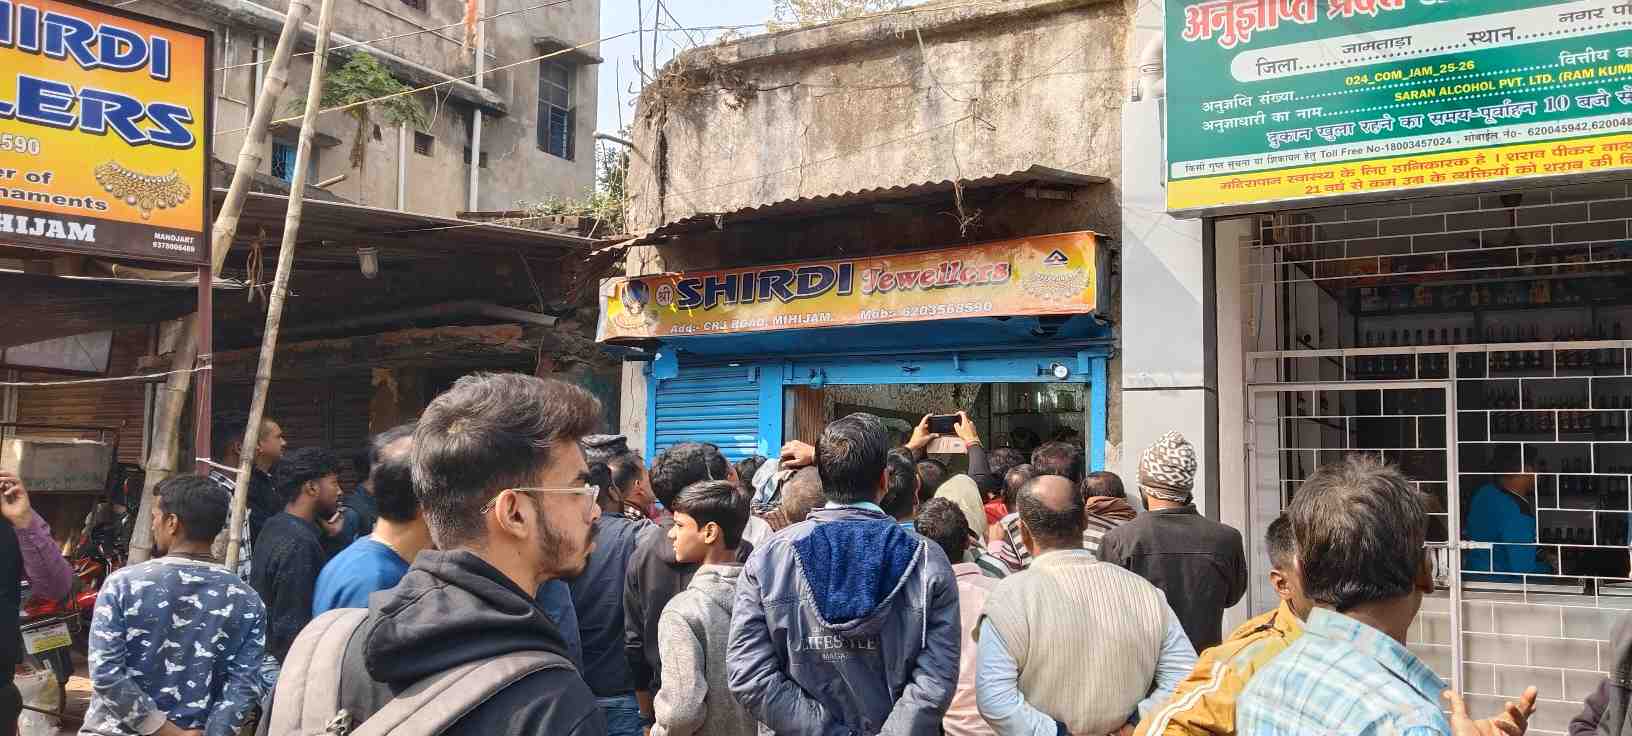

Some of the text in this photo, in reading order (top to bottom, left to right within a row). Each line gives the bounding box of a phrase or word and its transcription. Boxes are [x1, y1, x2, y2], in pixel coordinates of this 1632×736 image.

[1256, 56, 1298, 76] जिला
[1467, 26, 1516, 46] स्थान
[1558, 8, 1605, 22] नगर
[1345, 60, 1475, 86] 024_COM_JAM_25-26
[1558, 46, 1609, 67] वित्तीय
[0, 73, 194, 146] ERS
[1270, 111, 1290, 122] का
[1295, 107, 1323, 119] नाम
[1394, 88, 1436, 102] SARAN
[1439, 81, 1496, 97] ALCOHOL
[1499, 77, 1526, 89] PVT.
[1529, 73, 1556, 86] LTD.
[1559, 68, 1594, 83] (RAM
[1265, 127, 1313, 149] दुकान
[1316, 122, 1356, 142] खुला
[1359, 113, 1395, 134] रहने
[1398, 114, 1425, 130] का
[1544, 94, 1570, 113] 10
[1575, 88, 1611, 108] बजे
[1305, 185, 1321, 194] 21
[1350, 178, 1363, 190] से
[1369, 178, 1396, 188] कम
[1430, 172, 1446, 183] के
[1516, 161, 1537, 174] को
[1543, 160, 1583, 173] शराब
[1589, 154, 1612, 167] की
[1321, 149, 1338, 159] Toll
[1341, 147, 1363, 156] Free
[1340, 167, 1355, 177] के
[1360, 164, 1386, 176] लिए
[1392, 159, 1469, 174] हानिकारक
[1476, 153, 1486, 165] है
[1506, 149, 1545, 161] शराब
[1551, 144, 1595, 157] पीकर
[26, 171, 53, 185] of
[675, 260, 1011, 310] SHIRDI Jewellers
